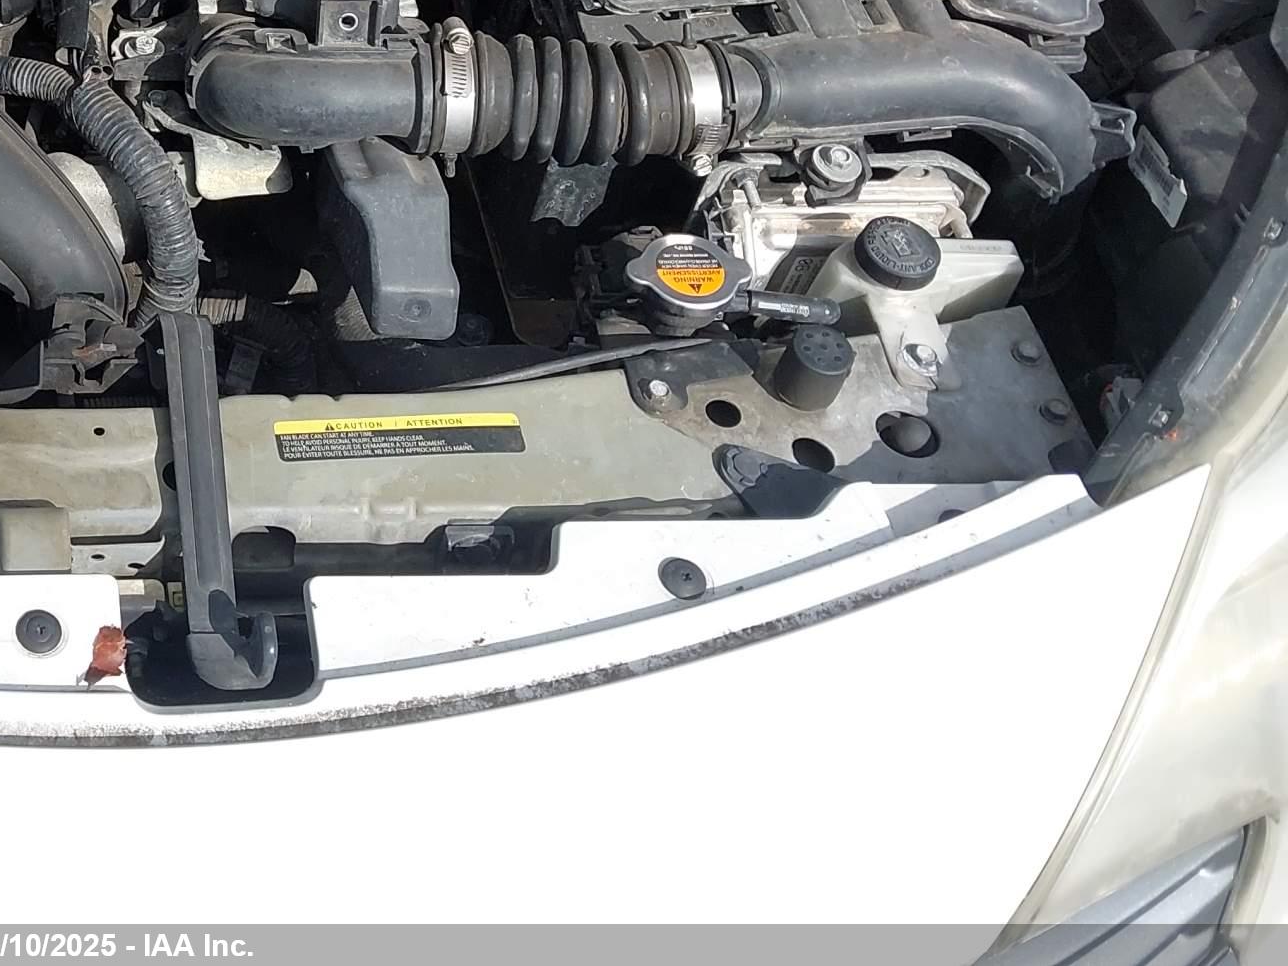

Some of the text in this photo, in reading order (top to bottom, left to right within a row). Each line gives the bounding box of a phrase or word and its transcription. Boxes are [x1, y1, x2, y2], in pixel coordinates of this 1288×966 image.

[335, 418, 463, 430] CAUTION ATTENTION
[330, 443, 352, 451] RISQUE
